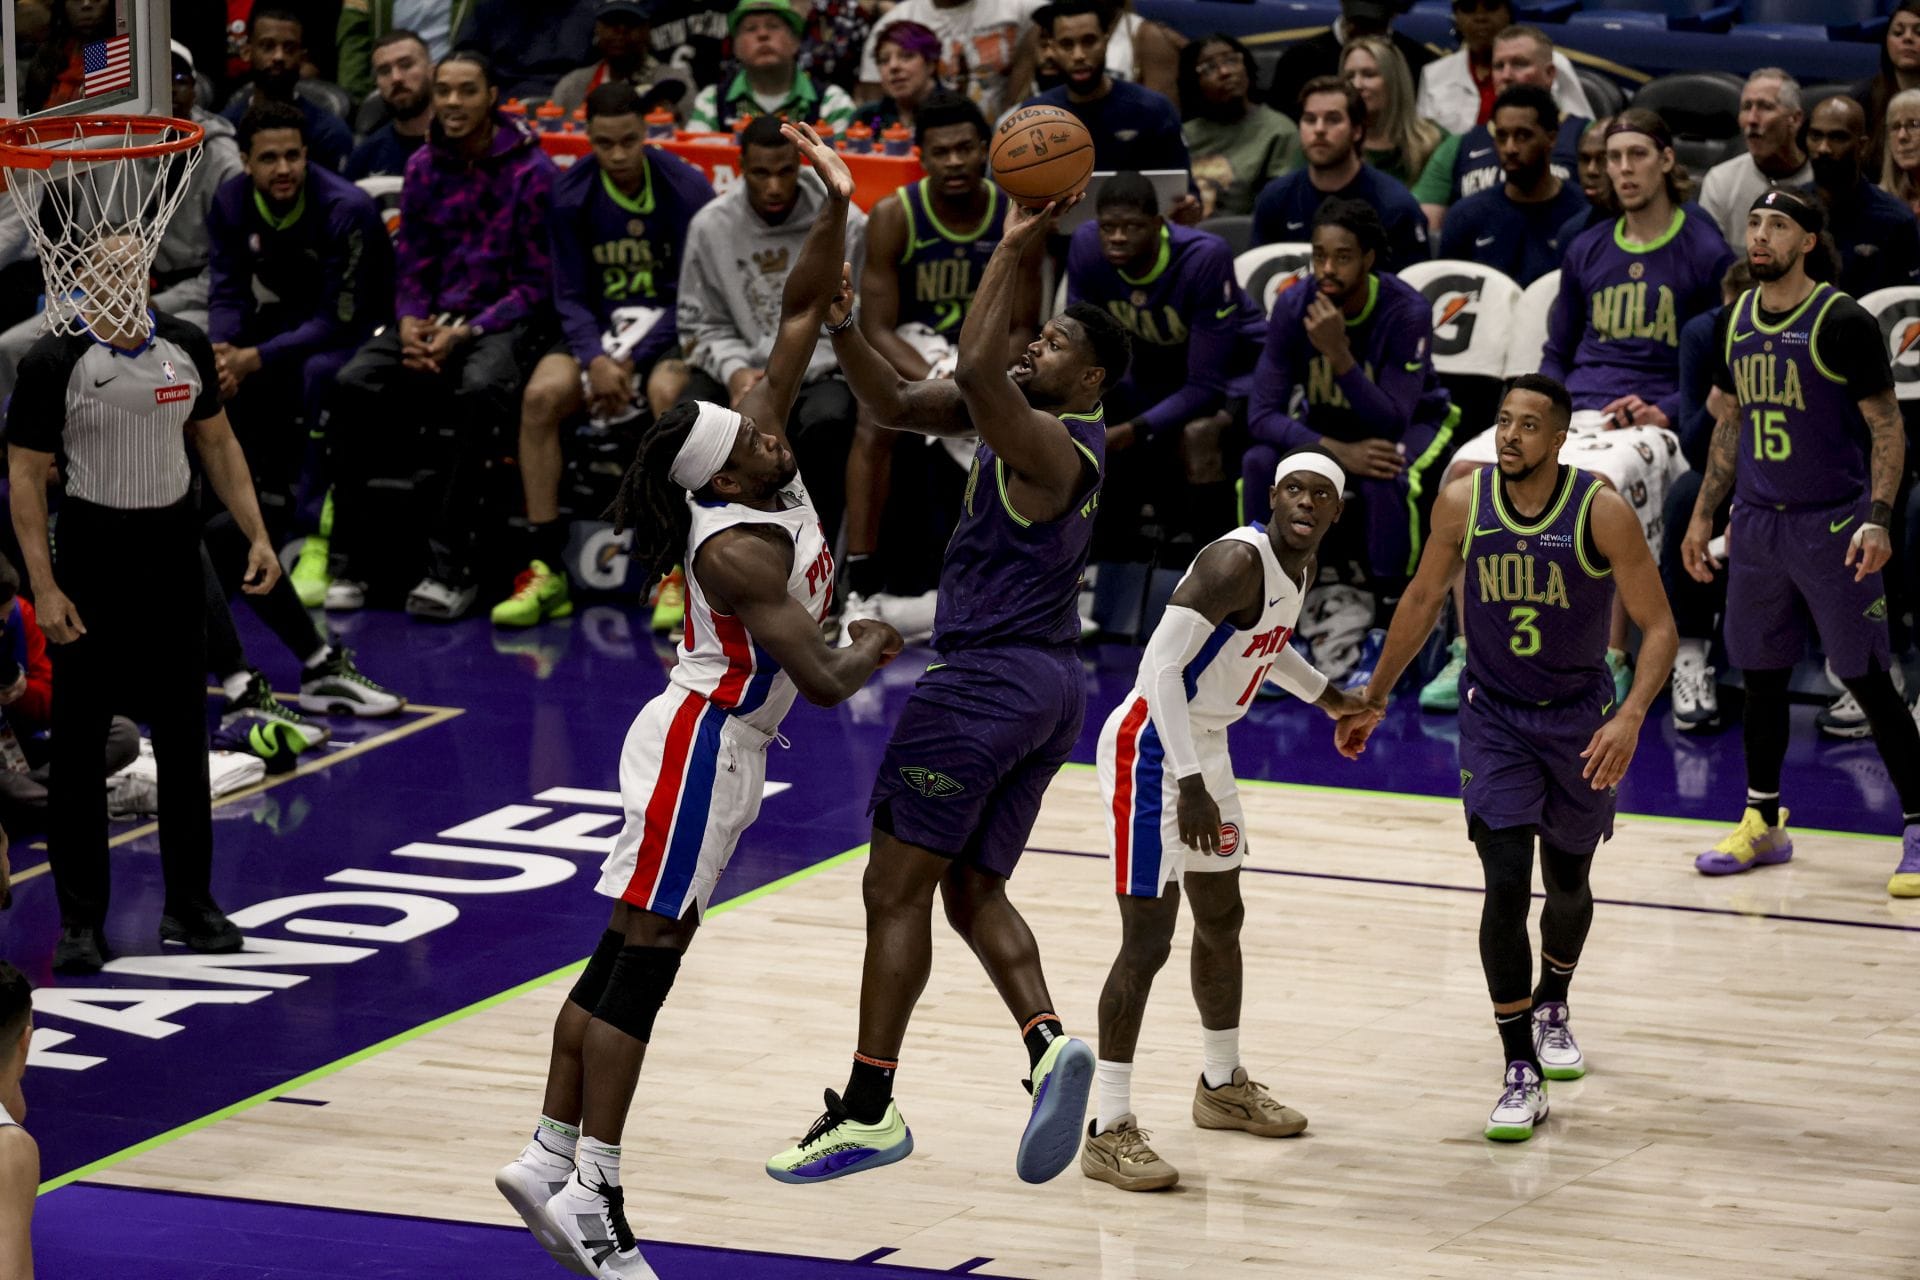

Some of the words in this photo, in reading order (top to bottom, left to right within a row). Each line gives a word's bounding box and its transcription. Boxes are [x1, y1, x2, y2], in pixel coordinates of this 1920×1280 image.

[603, 267, 657, 300] 24
[916, 259, 979, 302] NOL
[1591, 281, 1679, 347] NOLA
[1733, 352, 1806, 411] NOLA
[1749, 408, 1792, 461] 15
[1476, 553, 1571, 609] NOLA
[1508, 606, 1541, 657] 3
